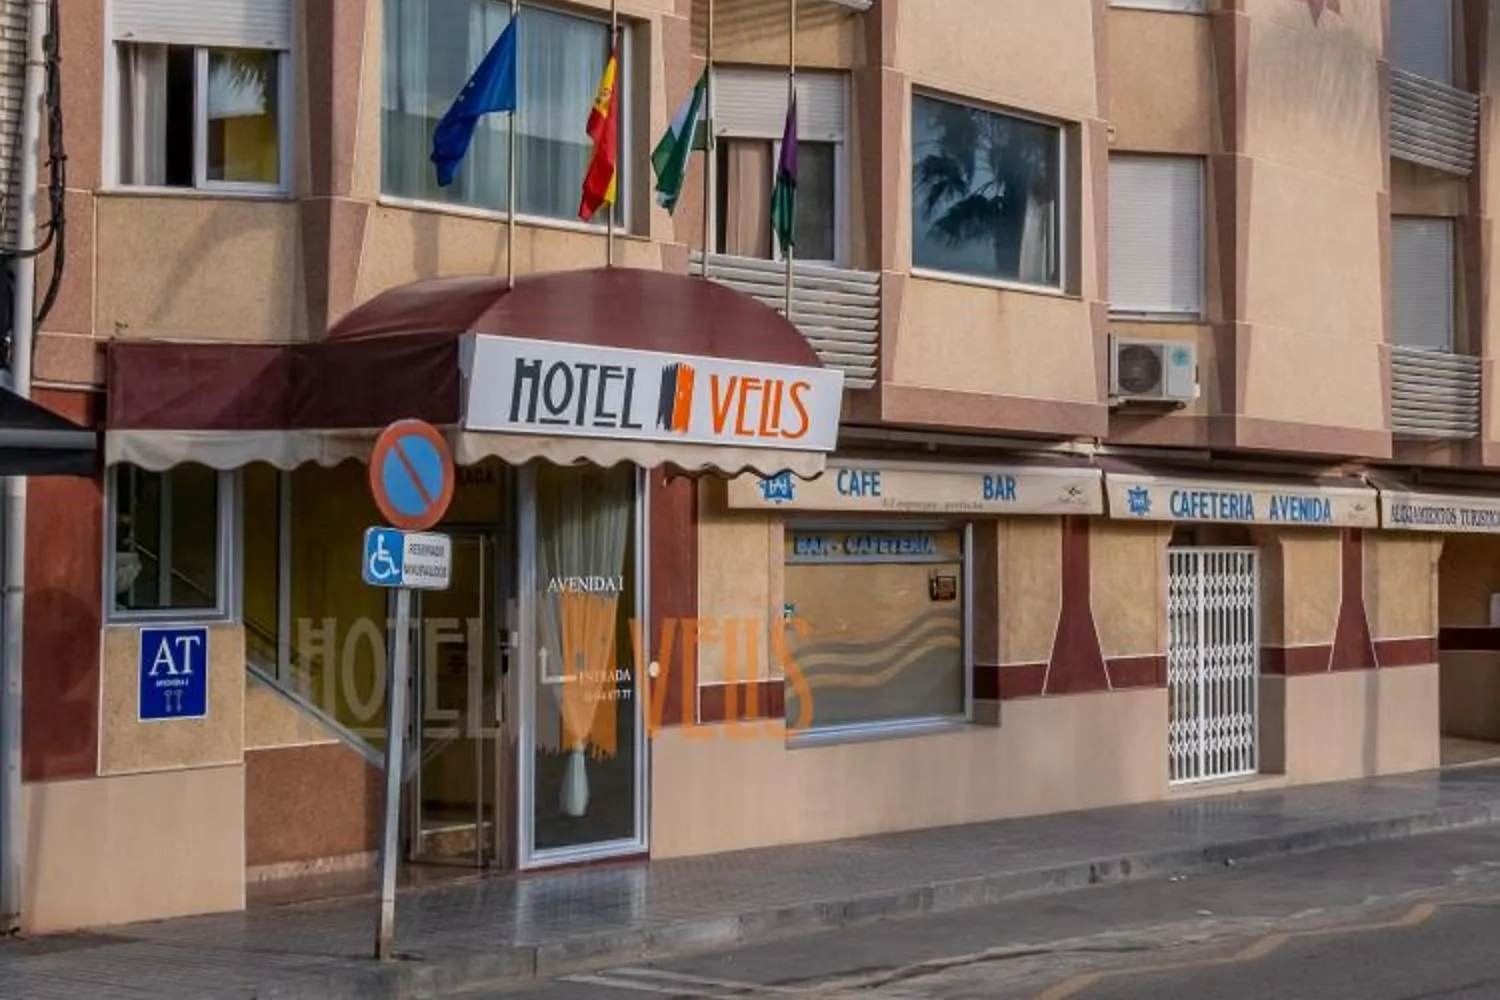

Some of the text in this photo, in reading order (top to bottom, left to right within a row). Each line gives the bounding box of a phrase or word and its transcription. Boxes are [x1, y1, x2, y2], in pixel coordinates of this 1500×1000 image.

[509, 357, 811, 439] HOTEL VELIS
[836, 469, 1017, 501] CAFE BAR
[1169, 489, 1255, 521] CAFETERIA
[1269, 495, 1333, 523] AVENIDA
[547, 575, 616, 593] AVENIDA
[148, 634, 201, 676] AT
